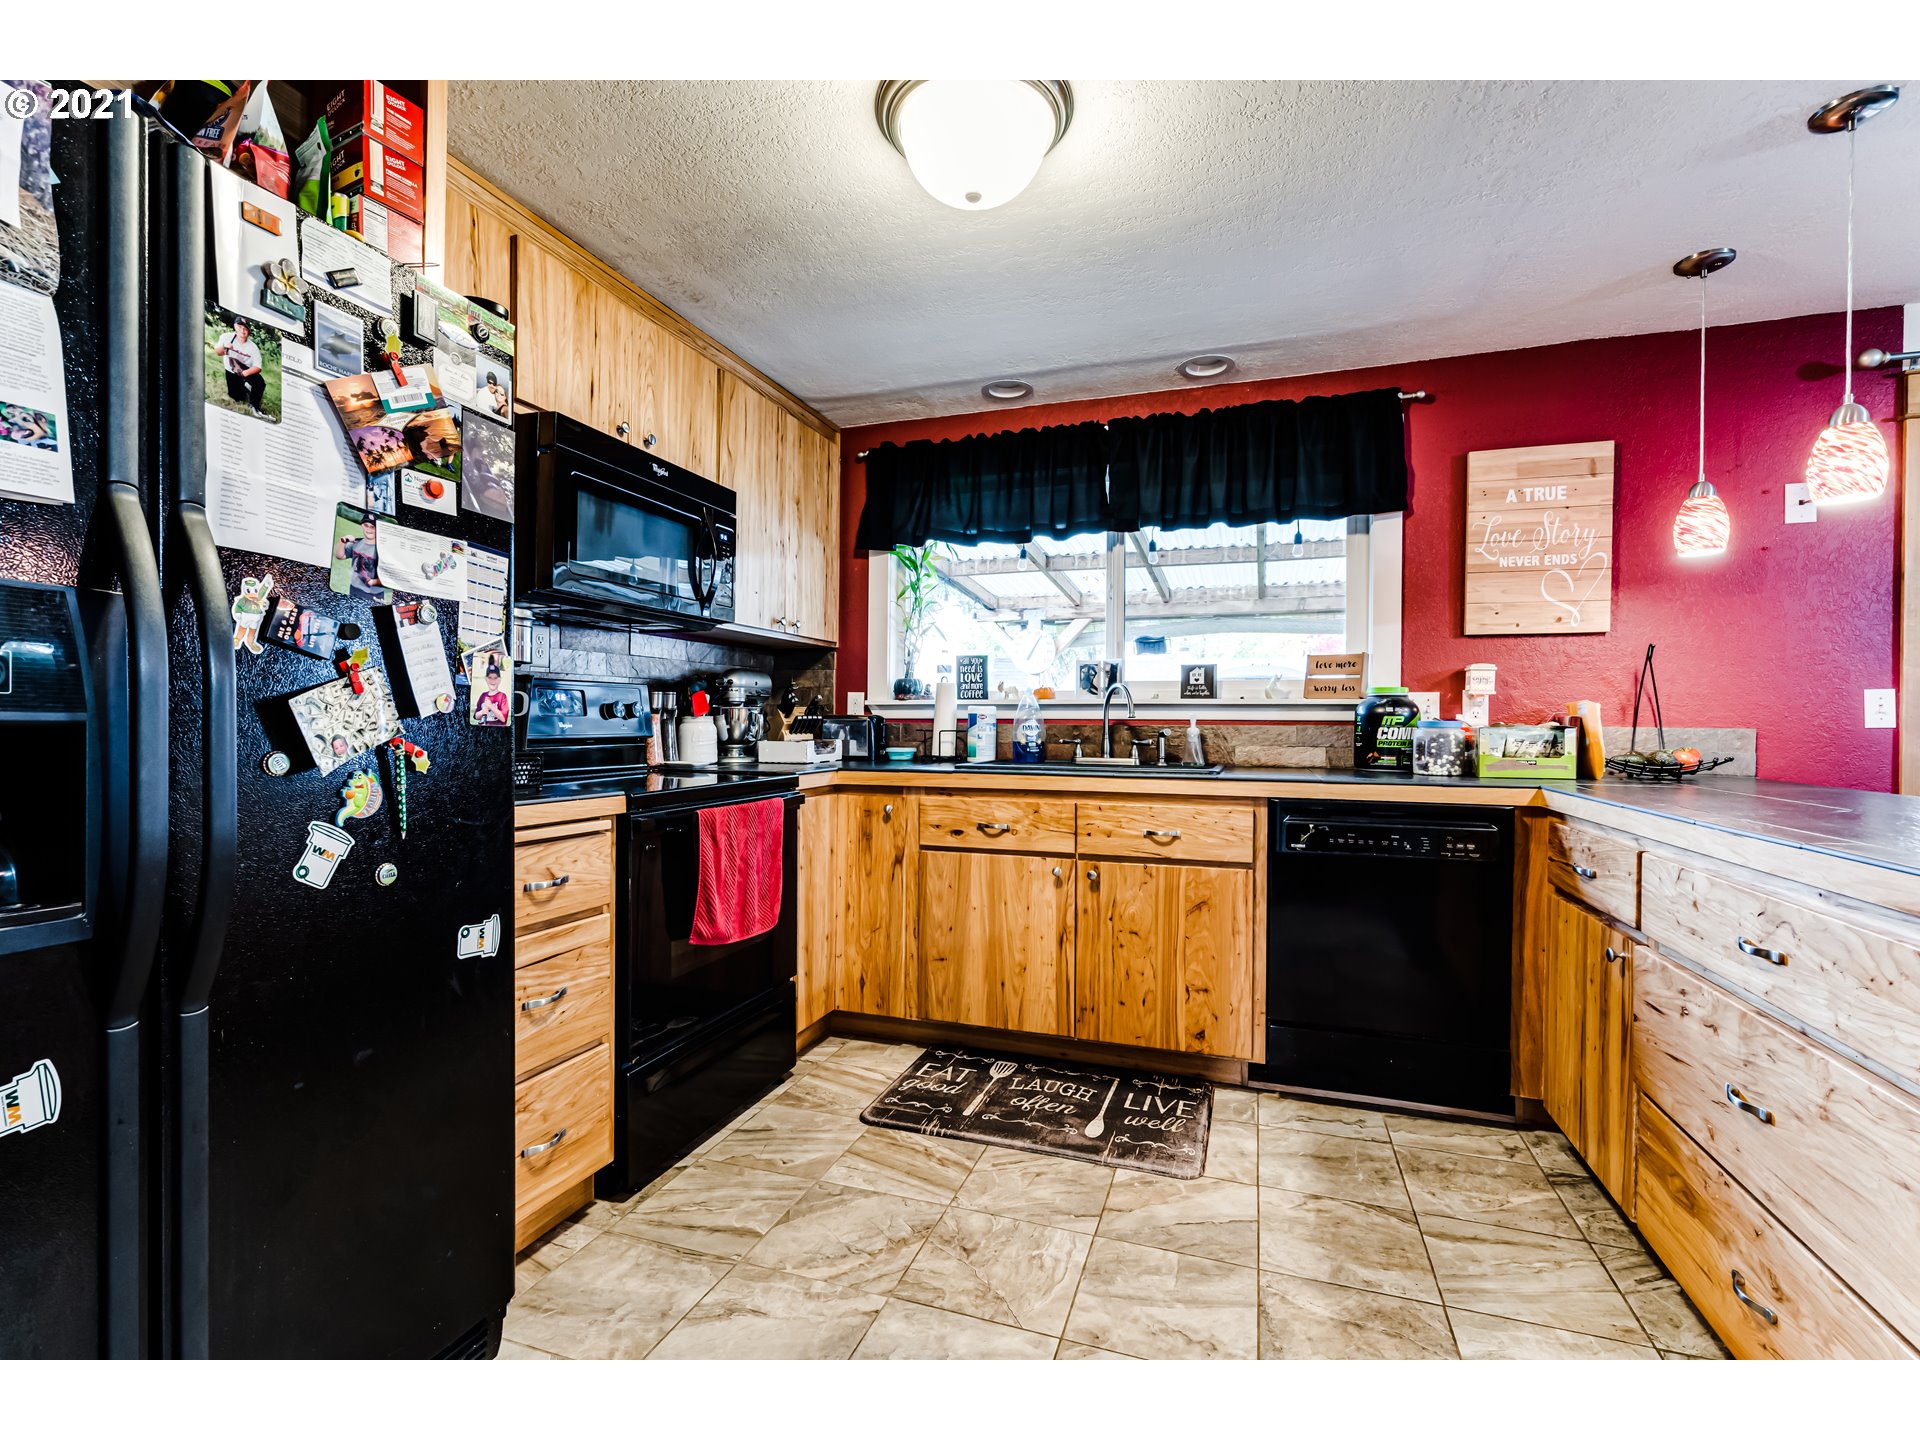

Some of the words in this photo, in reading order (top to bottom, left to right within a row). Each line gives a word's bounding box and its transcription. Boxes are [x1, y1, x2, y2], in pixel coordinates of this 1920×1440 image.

[326, 89, 346, 111] EIGHT
[385, 93, 406, 107] EIGHT
[205, 127, 221, 139] FREE
[385, 155, 405, 167] EIGHT
[1505, 488, 1518, 504] A
[1523, 485, 1568, 504] TRUE
[1472, 515, 1526, 561] Love
[1529, 510, 1601, 560] Story
[1499, 555, 1540, 568] NEVER
[1544, 553, 1578, 566] ENDS
[959, 664, 976, 673] need
[977, 664, 984, 673] is
[1315, 660, 1333, 669] love
[1335, 661, 1357, 669] more
[959, 682, 970, 690] and
[1313, 685, 1338, 694] worry
[1341, 684, 1356, 692] less
[1381, 715, 1405, 726] MP
[312, 844, 335, 861] WM
[479, 927, 485, 949] WM
[915, 1062, 978, 1083] EAT
[898, 1078, 968, 1095] good
[1008, 1077, 1098, 1103] LAUGH
[5, 1089, 22, 1127] WM
[1010, 1094, 1078, 1115] often
[1123, 1092, 1198, 1119] LIVE
[1124, 1114, 1188, 1133] well
